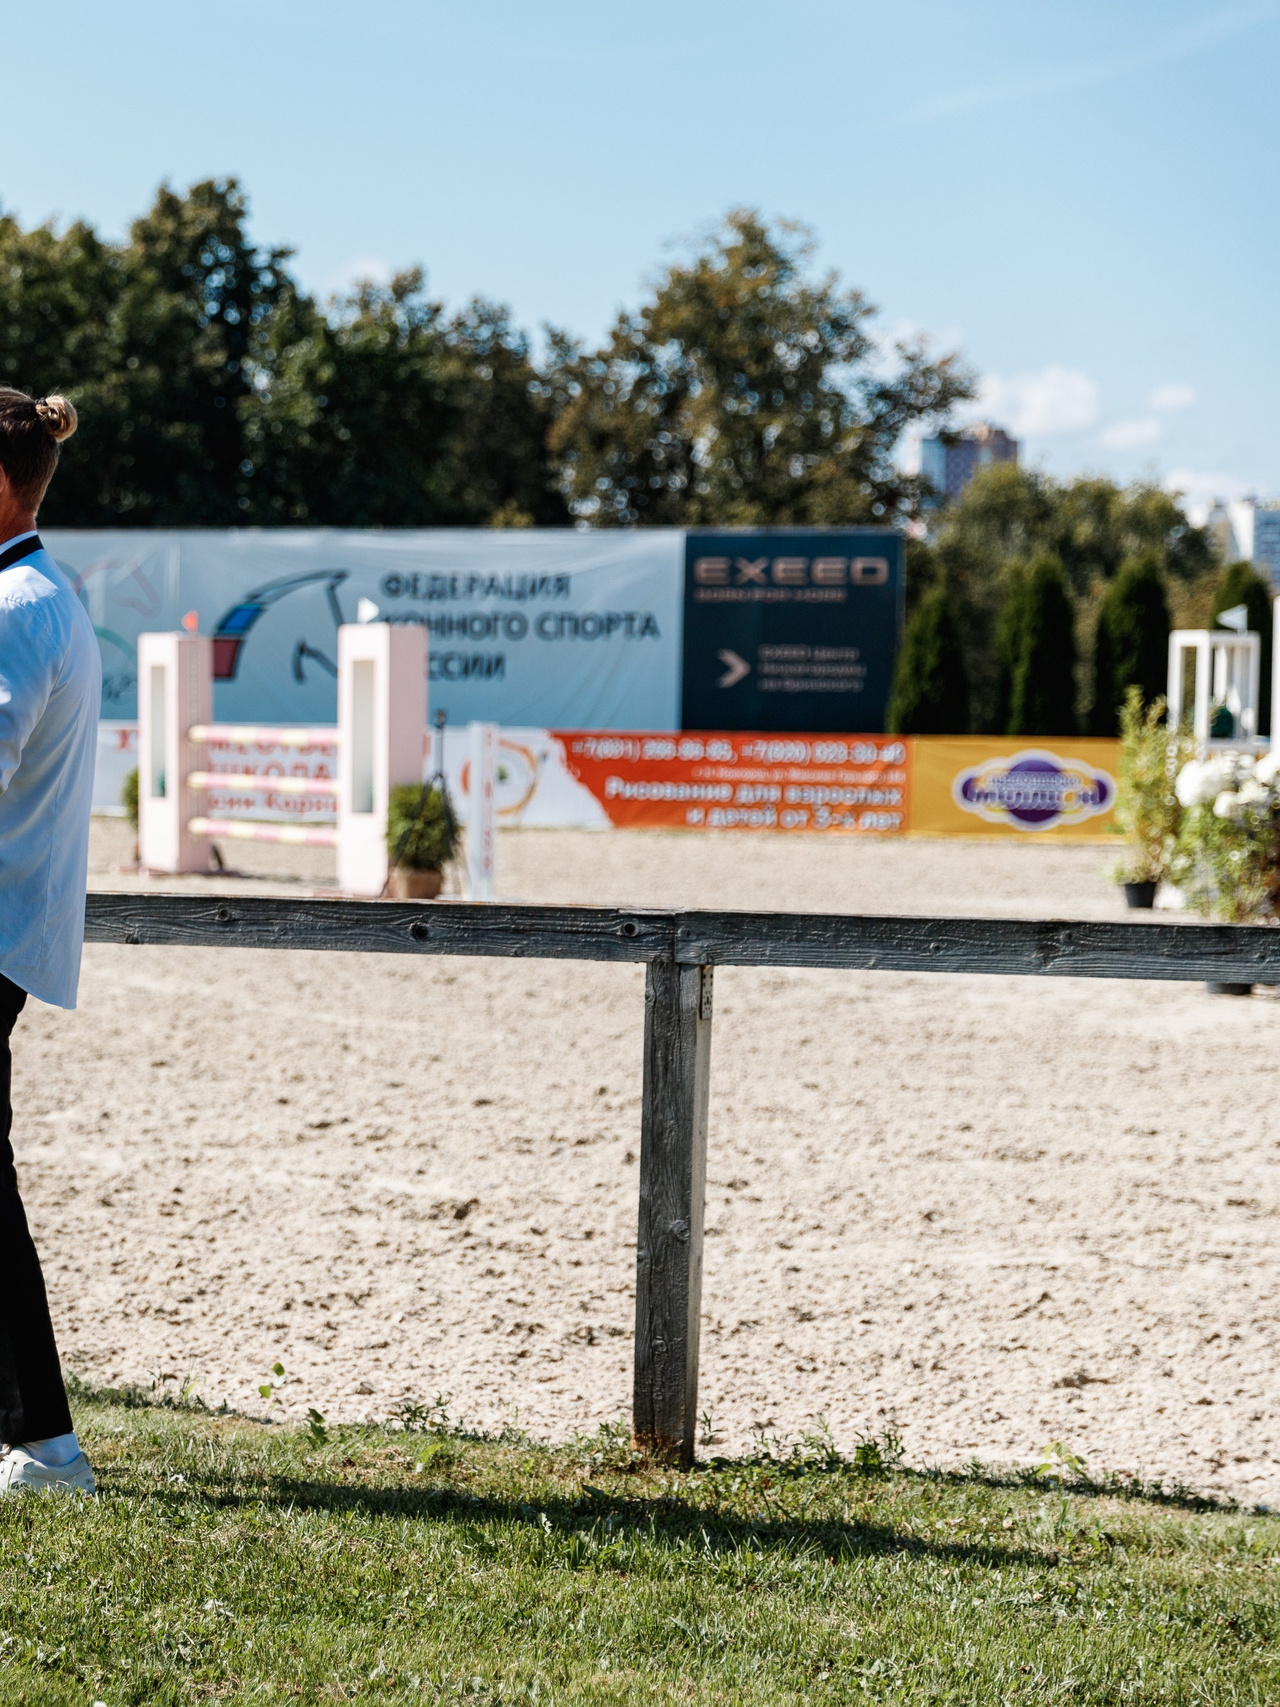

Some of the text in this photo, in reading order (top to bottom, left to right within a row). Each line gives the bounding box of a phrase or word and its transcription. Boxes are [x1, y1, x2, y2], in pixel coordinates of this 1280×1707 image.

[695, 558, 887, 585] EXEED
[380, 571, 572, 604] ФЕДЕРАЦИЯ
[534, 610, 661, 642] СПОРТА
[427, 651, 506, 681] ССИИ
[607, 777, 732, 801] Рисование
[735, 785, 781, 804] для
